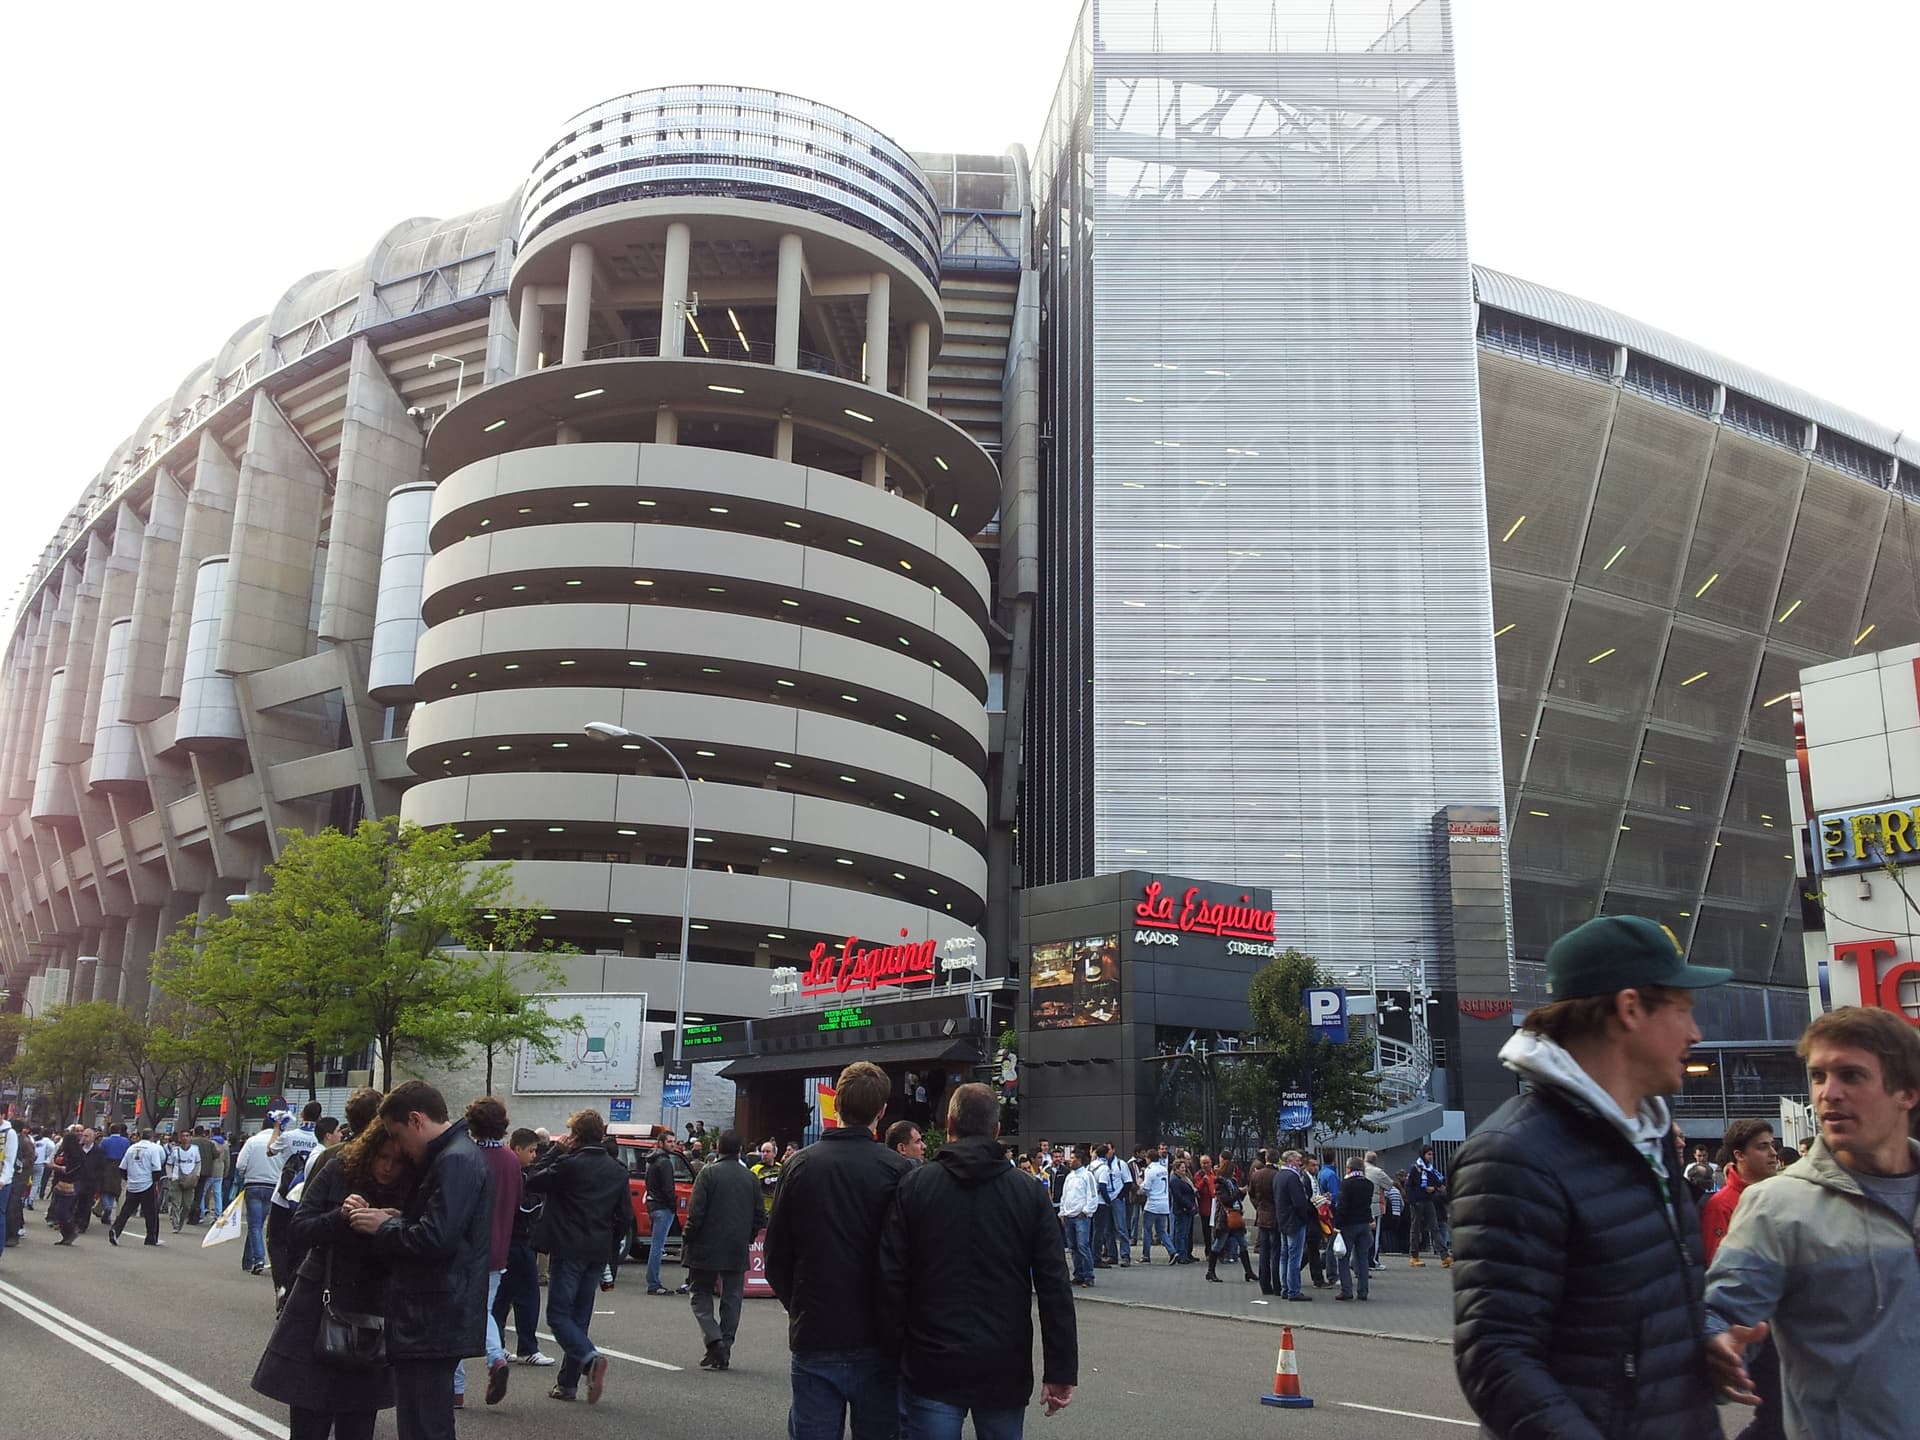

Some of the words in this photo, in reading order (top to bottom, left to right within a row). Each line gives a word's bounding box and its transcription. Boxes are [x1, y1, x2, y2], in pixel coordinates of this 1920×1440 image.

[1823, 819, 1845, 863] TGI
[1135, 881, 1175, 919] La
[1179, 886, 1277, 936] Esquina
[1134, 930, 1179, 946] ASADOR
[801, 942, 836, 986] La
[836, 928, 937, 993] Esquina
[1310, 991, 1340, 1026] P
[1283, 1099, 1308, 1107] Parking
